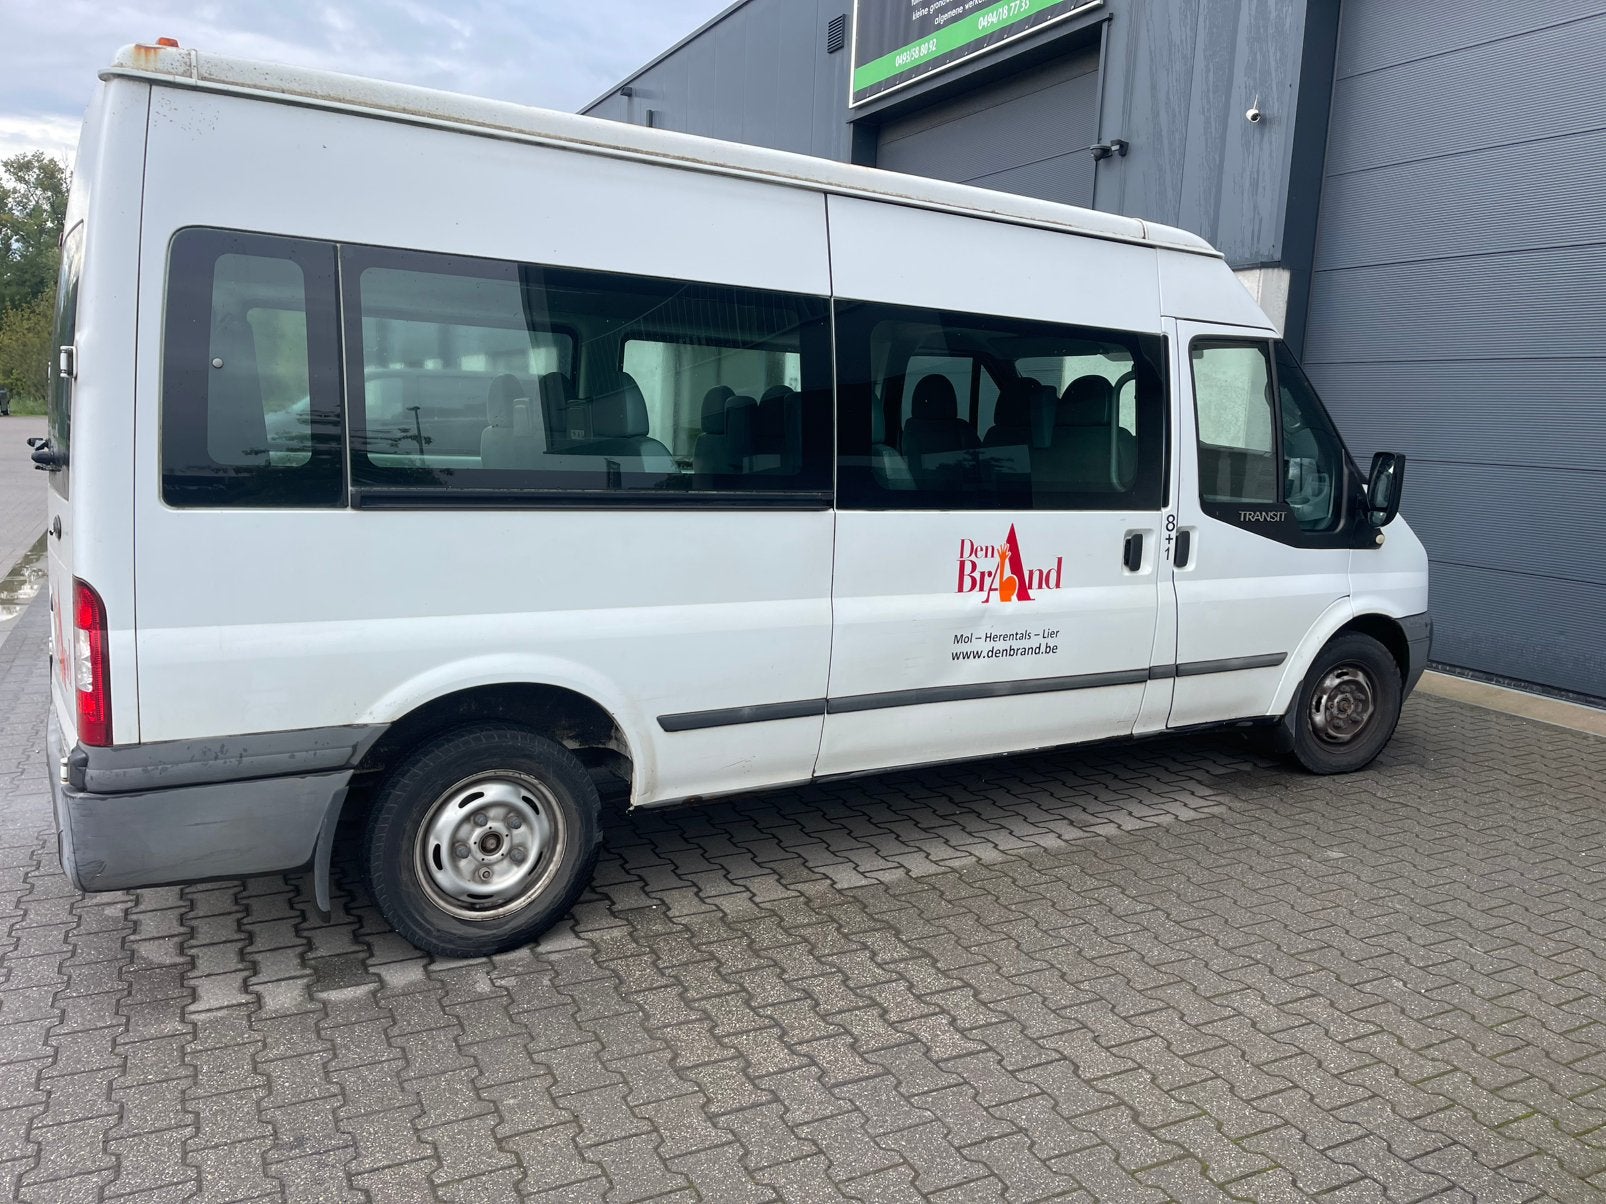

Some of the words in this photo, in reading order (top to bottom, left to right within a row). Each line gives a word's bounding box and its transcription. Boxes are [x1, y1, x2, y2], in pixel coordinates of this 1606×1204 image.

[934, 6, 963, 24] algemene
[978, 4, 1008, 30] 0494/18
[1239, 511, 1287, 522] TRANSIT
[959, 538, 996, 559] Den
[953, 633, 973, 644] Mol
[984, 629, 1032, 643] Herentals
[1042, 628, 1060, 639] Lier
[951, 642, 1058, 661] www.denbrand.be
